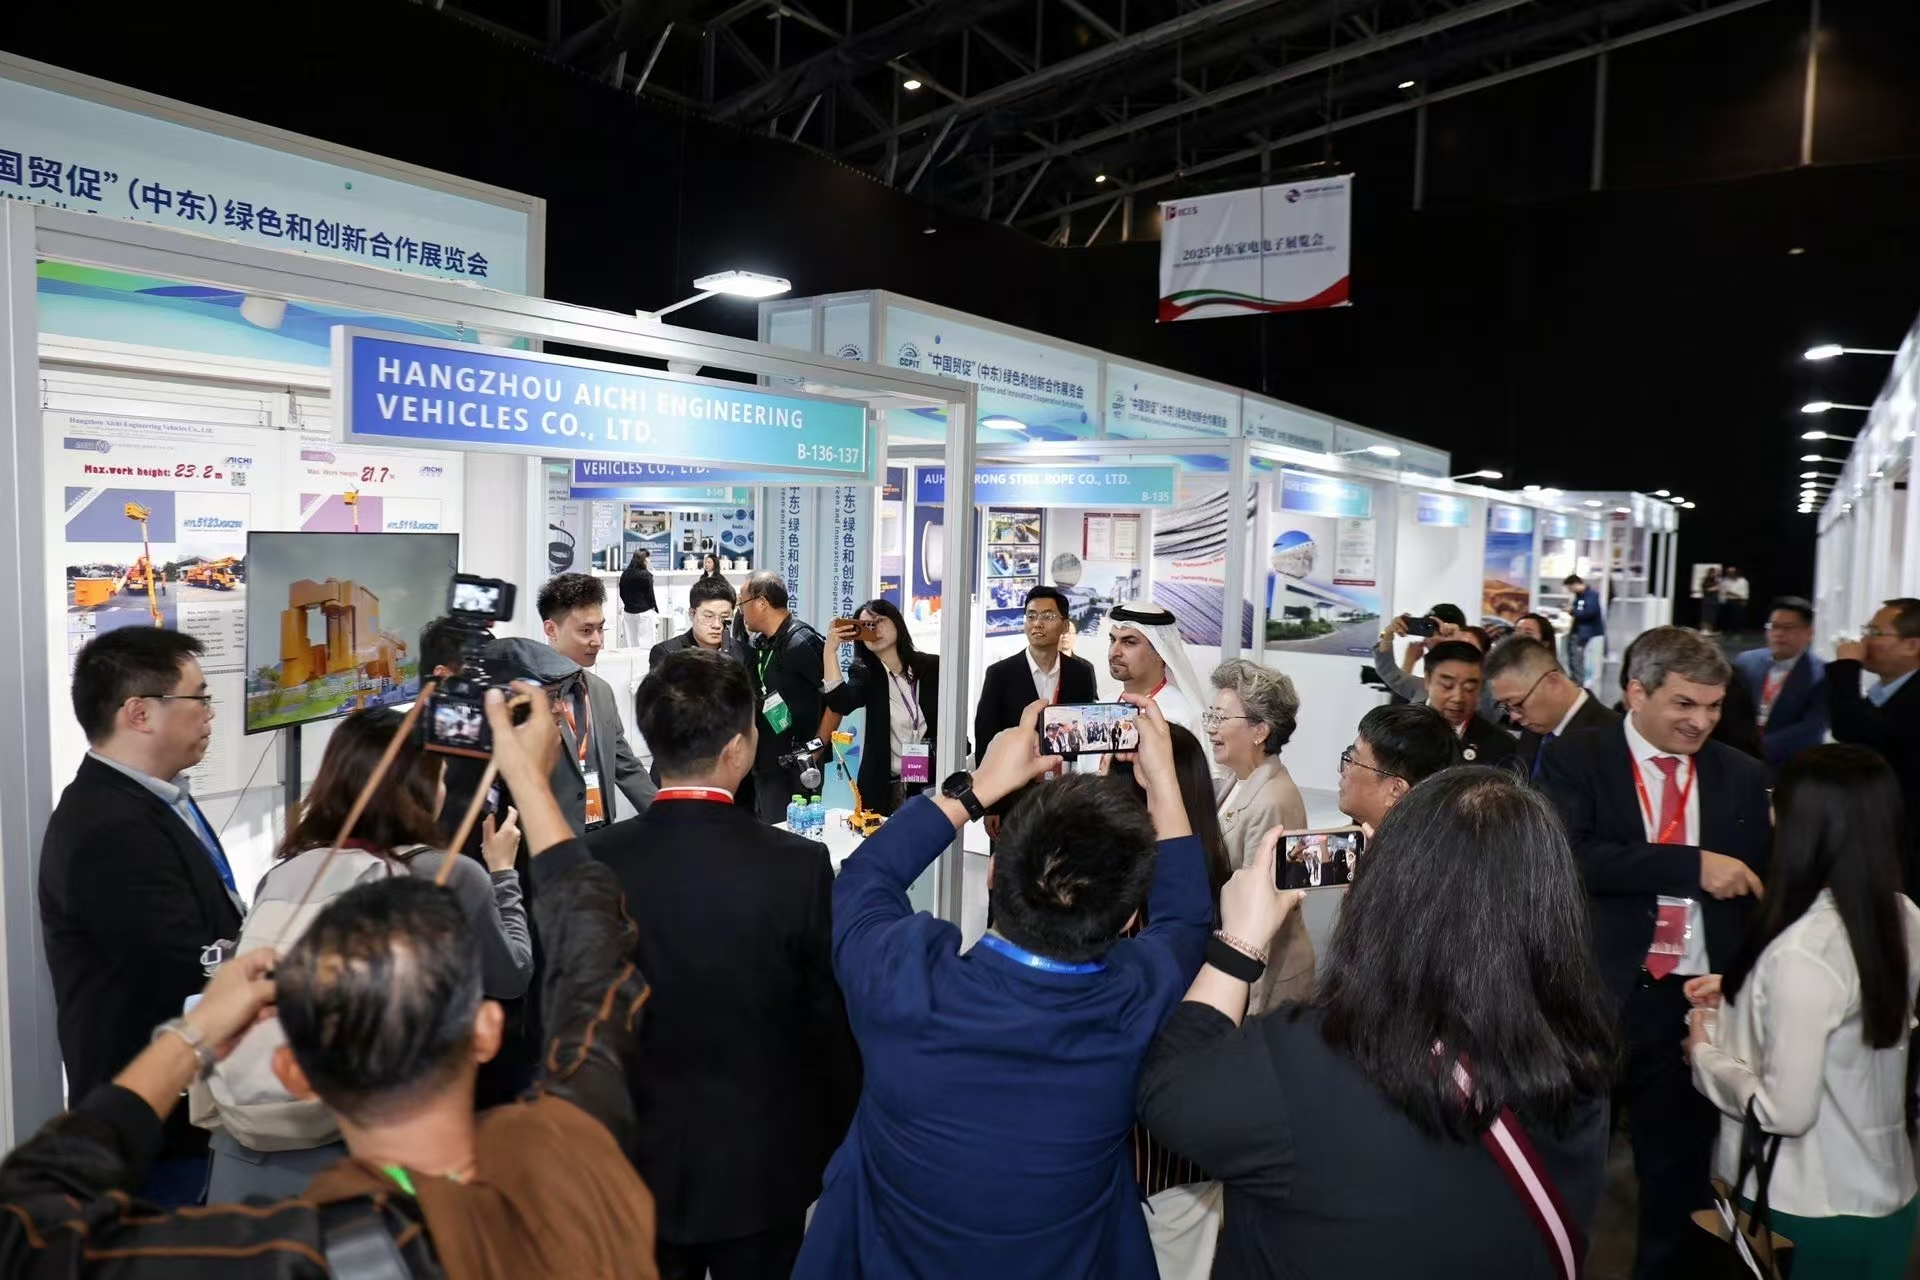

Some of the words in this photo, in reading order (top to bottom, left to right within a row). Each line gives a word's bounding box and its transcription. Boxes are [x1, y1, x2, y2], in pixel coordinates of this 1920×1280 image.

[900, 357, 920, 369] CCPIT
[377, 356, 562, 402] HANGZHOU
[574, 382, 647, 416] AICHI
[657, 395, 803, 429] ENGINEERING
[376, 393, 529, 432] VEHICLES
[541, 411, 594, 441] CO.,
[607, 416, 658, 444] LTD.
[225, 456, 253, 465] AICHI
[797, 443, 859, 464] B-136-137
[84, 464, 134, 476] Max.work
[137, 465, 171, 478] height:
[174, 463, 213, 479] 23.2
[360, 465, 390, 483] 21.7
[583, 461, 643, 476] VEHICLES
[648, 464, 675, 476] CO.,
[974, 473, 1006, 486] RONG
[1009, 473, 1042, 486] STEEL
[1044, 473, 1075, 486] ROPE
[1078, 473, 1101, 487] CO.,
[1105, 473, 1131, 486] LTD.
[1141, 491, 1170, 502] B-135
